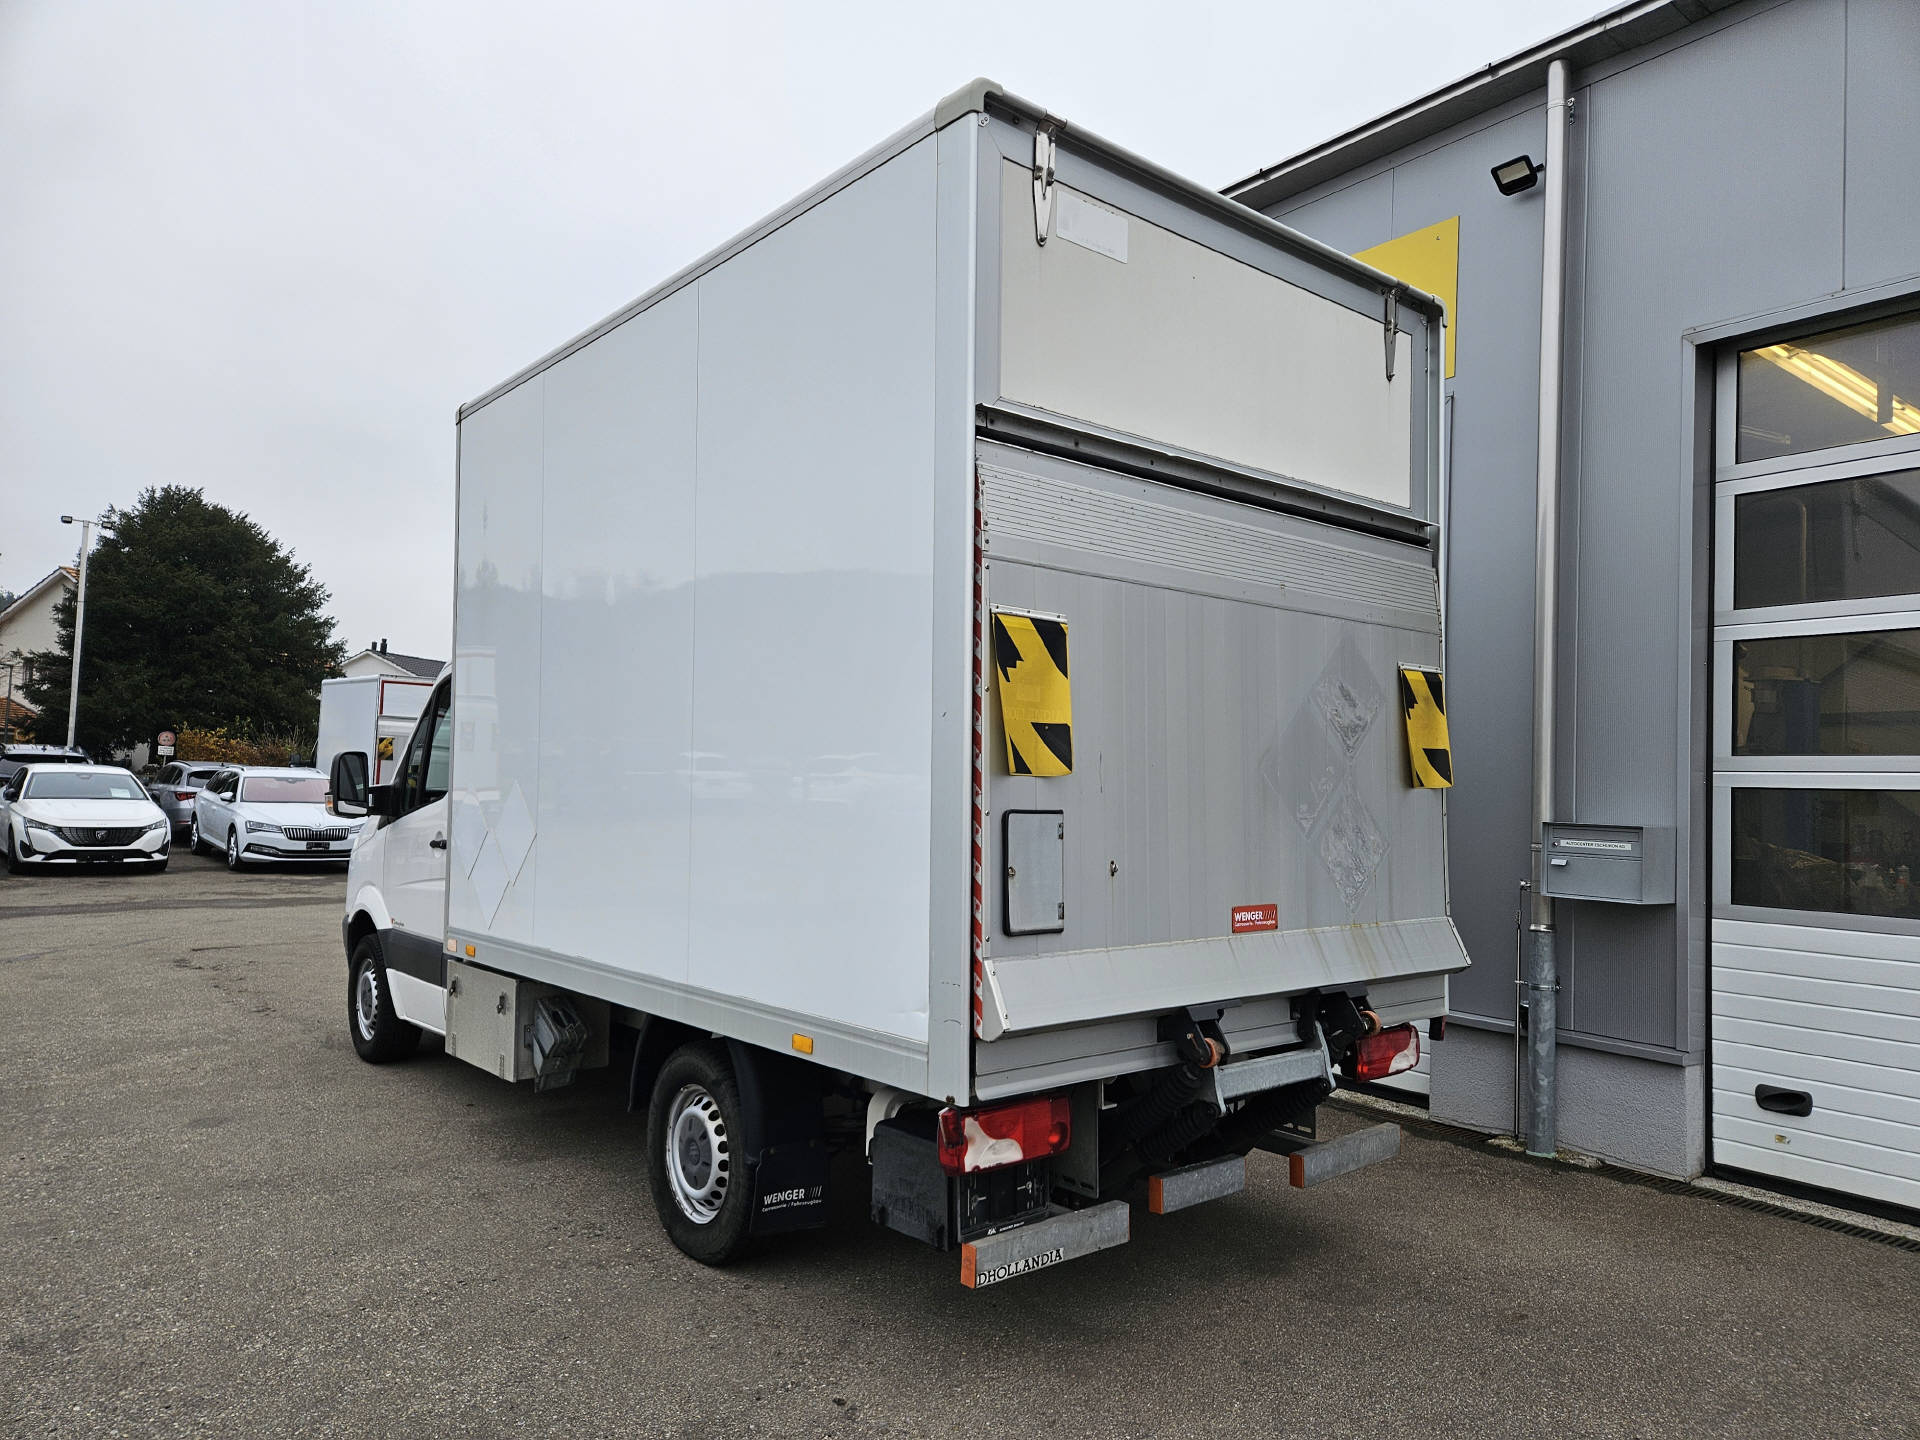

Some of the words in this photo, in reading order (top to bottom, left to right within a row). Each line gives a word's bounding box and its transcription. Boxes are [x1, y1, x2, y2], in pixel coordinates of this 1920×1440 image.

[1234, 911, 1263, 922] WENGER
[764, 1188, 805, 1205] WENGER
[978, 1249, 1062, 1286] DHOLLANDIA
